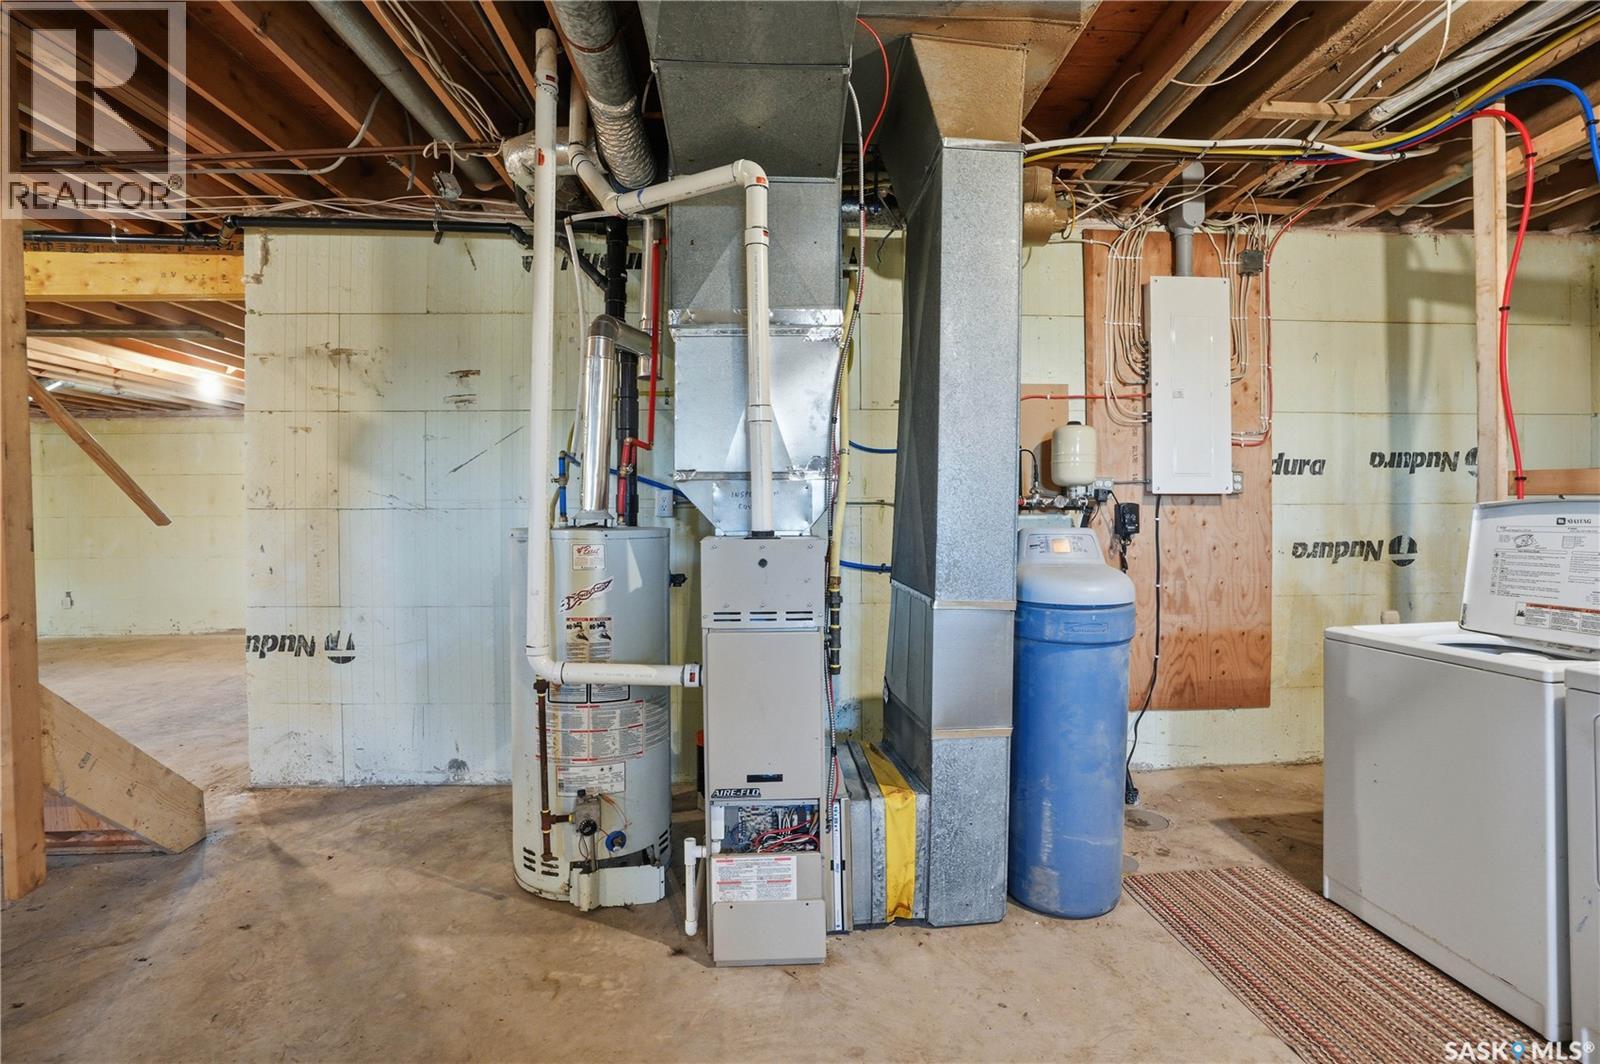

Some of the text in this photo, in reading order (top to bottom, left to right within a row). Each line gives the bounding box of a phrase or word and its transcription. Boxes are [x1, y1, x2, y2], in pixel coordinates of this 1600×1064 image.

[1369, 450, 1460, 475] Nudura
[1291, 540, 1384, 564] Nudura
[713, 789, 759, 797] AIRE-FLO
